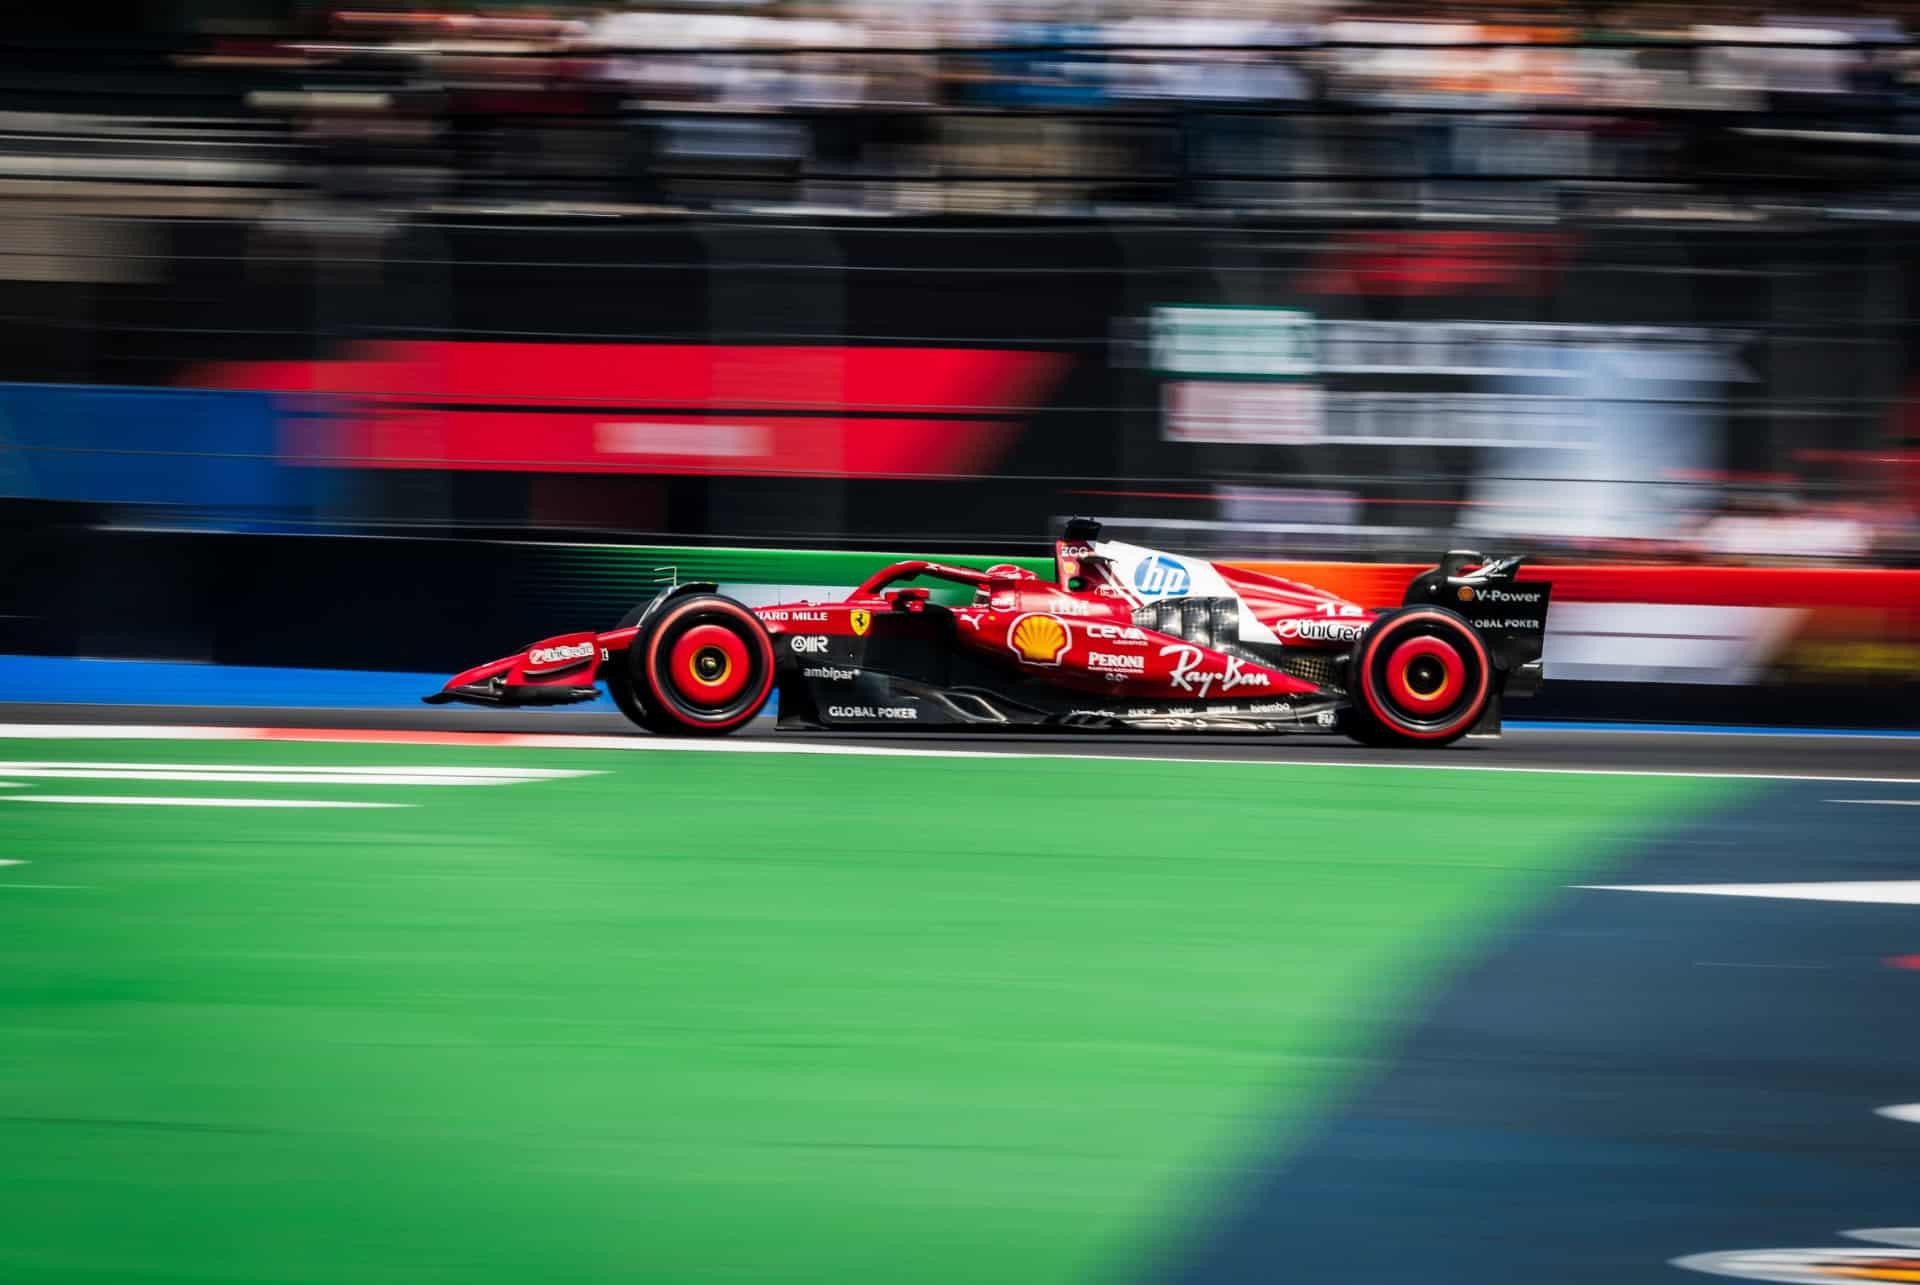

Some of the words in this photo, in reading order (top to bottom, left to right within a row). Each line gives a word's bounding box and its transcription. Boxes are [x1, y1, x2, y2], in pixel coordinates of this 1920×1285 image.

[1140, 553, 1187, 597] hp
[1475, 589, 1541, 602] V-Power
[755, 611, 789, 621] HARD
[792, 611, 828, 621] MILLE
[1474, 618, 1503, 629] OBAL
[1504, 619, 1540, 629] POKER
[1299, 620, 1366, 642] UniCred
[1088, 651, 1145, 669] PERONI
[804, 667, 854, 681] ambipar
[828, 706, 877, 718] GLOBAL
[878, 708, 918, 720] POKER
[1250, 702, 1291, 713] brembo
